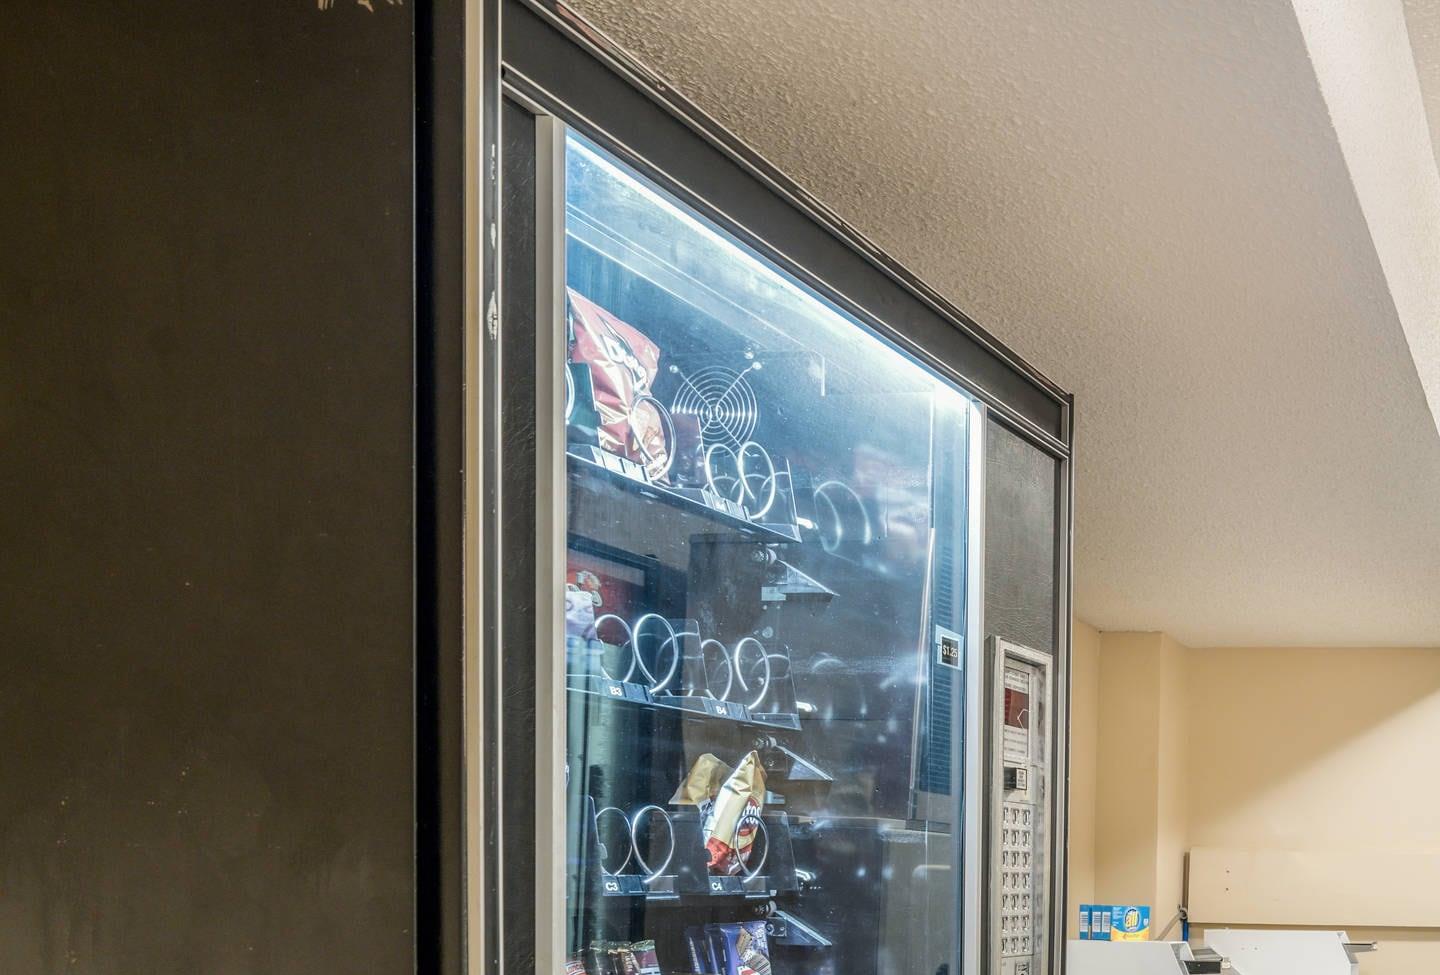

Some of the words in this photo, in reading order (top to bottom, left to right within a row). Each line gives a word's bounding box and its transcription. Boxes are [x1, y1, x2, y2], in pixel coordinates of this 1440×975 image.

[942, 645, 958, 658] $1.25
[609, 685, 622, 696] B3
[605, 881, 618, 891] C3
[712, 881, 723, 891] C4
[1126, 910, 1138, 928] all
